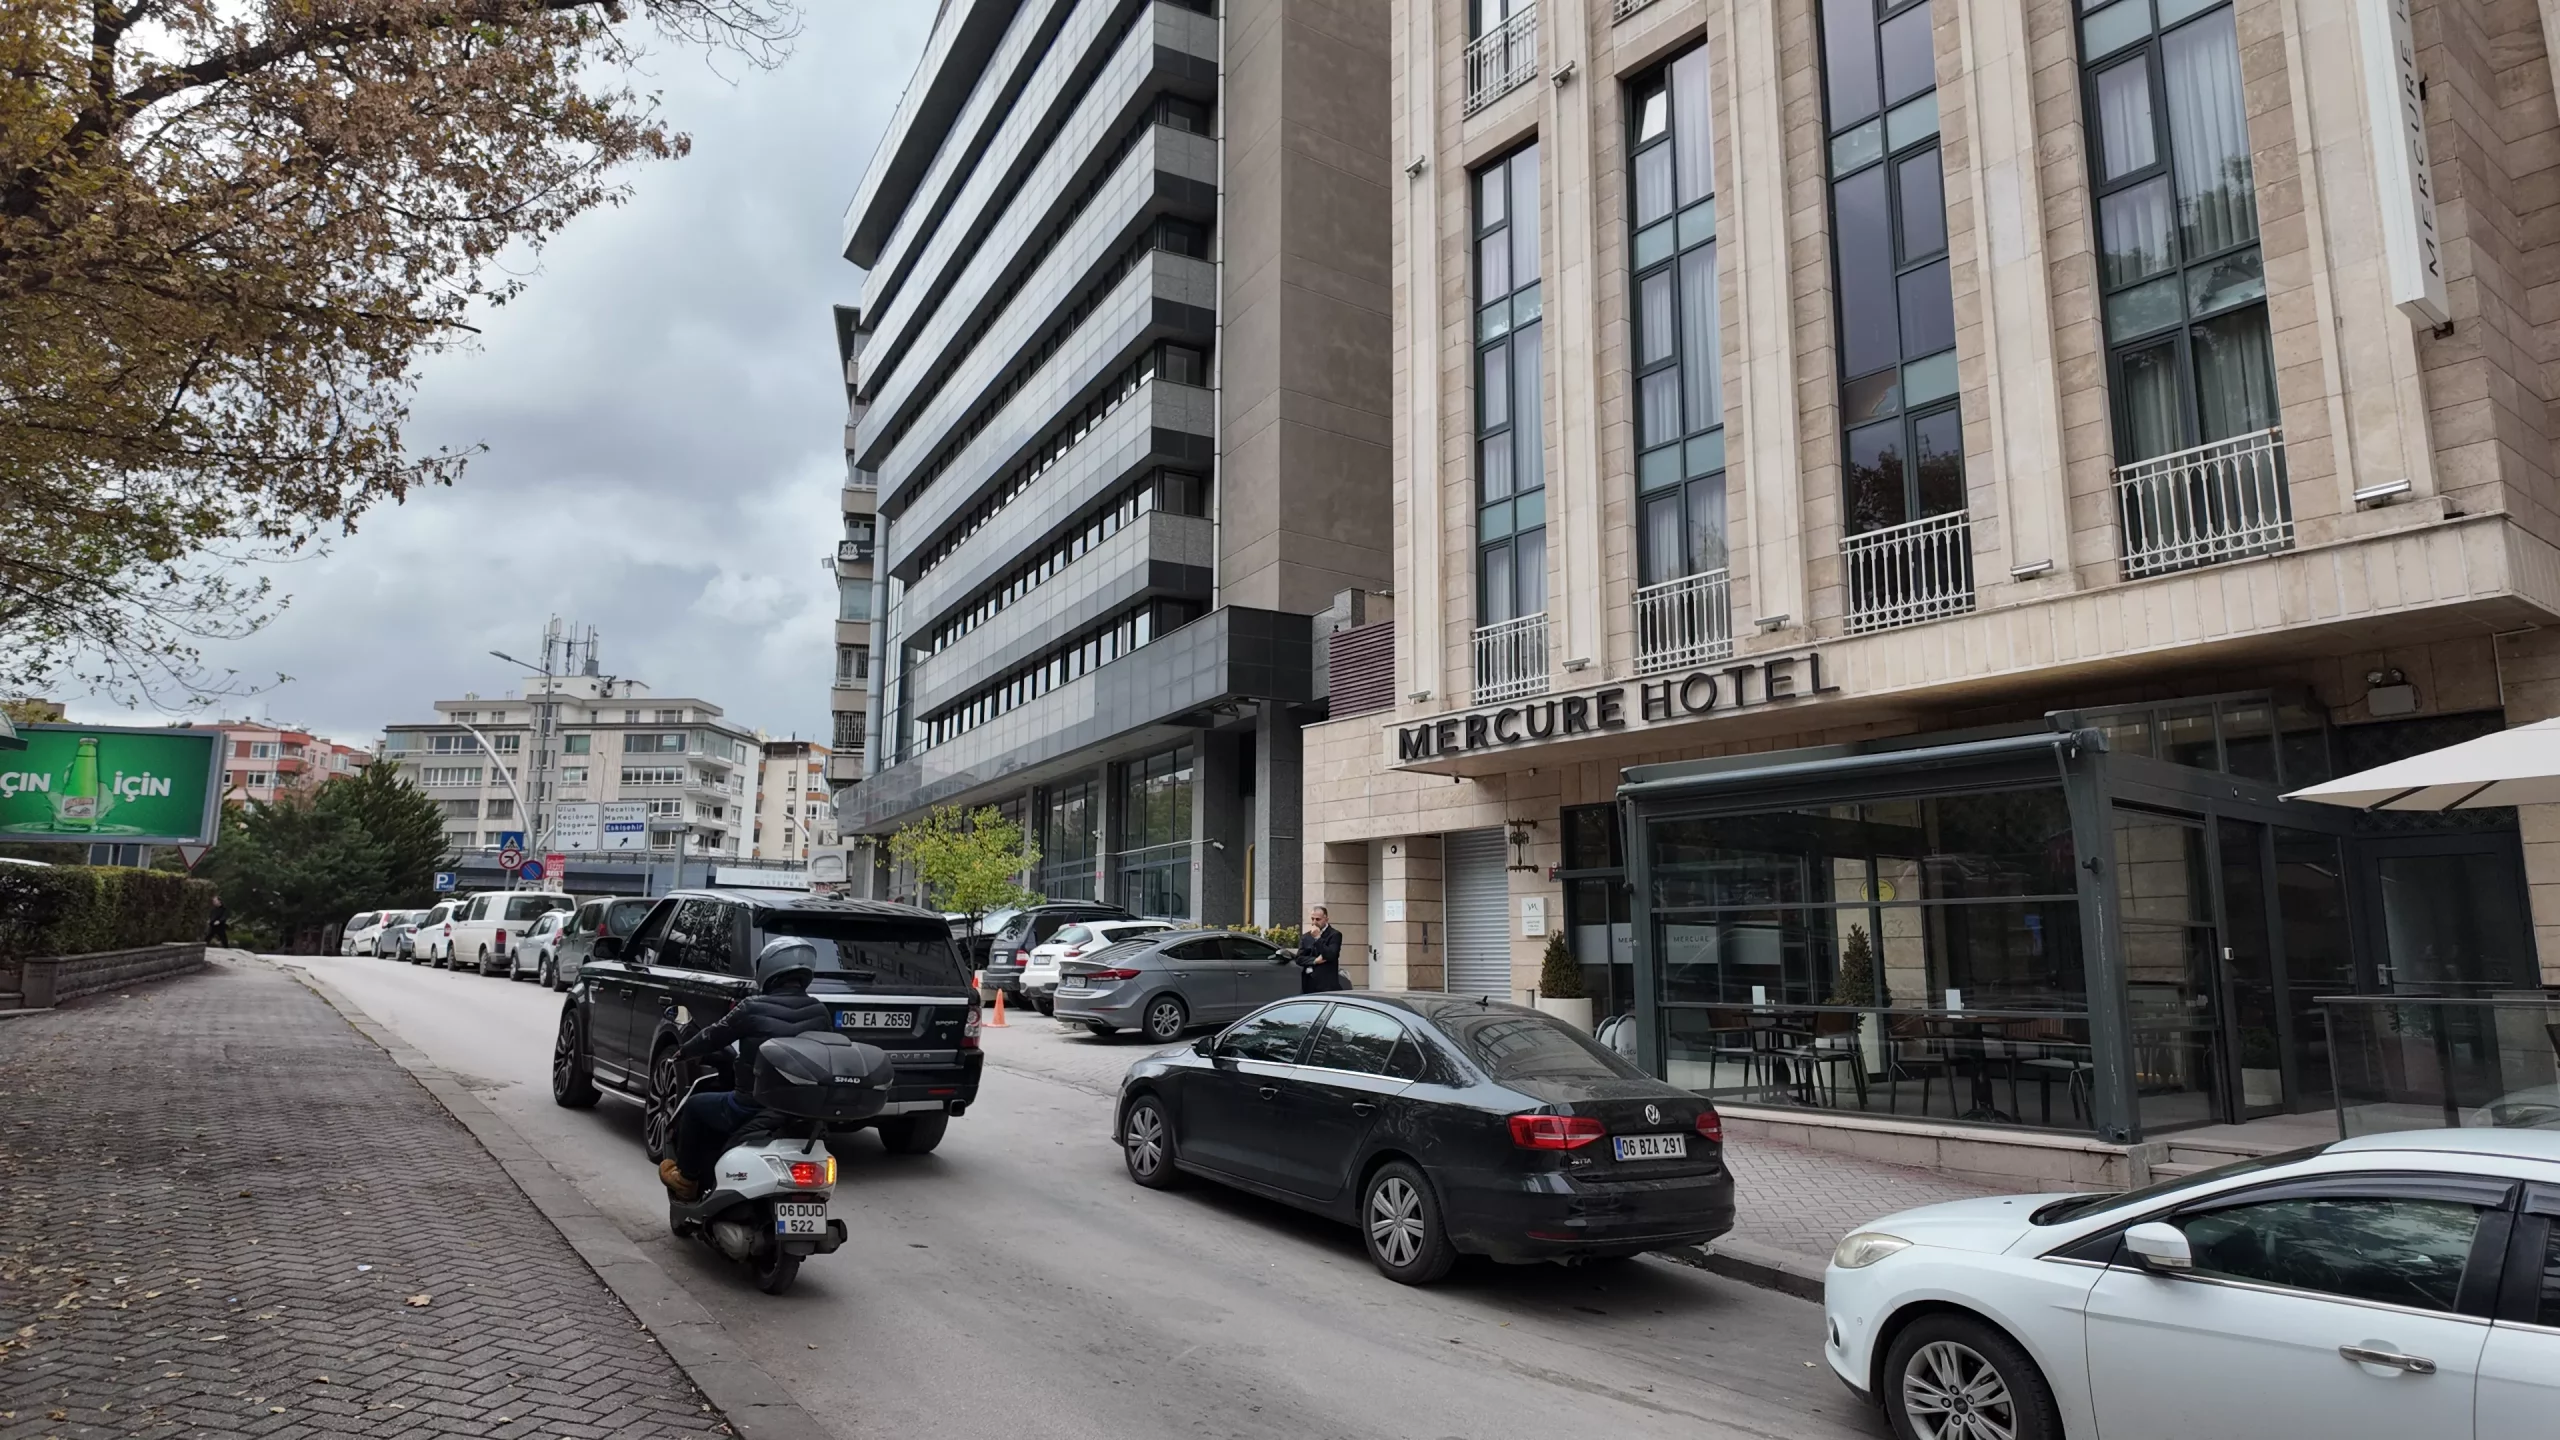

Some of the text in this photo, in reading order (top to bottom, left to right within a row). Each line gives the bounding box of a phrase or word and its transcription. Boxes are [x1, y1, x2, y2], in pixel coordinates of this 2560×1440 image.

[2400, 39, 2440, 278] MERCURE
[1398, 652, 1840, 760] MERCURE HOTEL
[113, 771, 171, 802] İÇİN
[1673, 935, 1710, 943] MERCURE
[842, 1012, 911, 1027] 06 EA 2659
[1622, 1137, 1682, 1156] 06 BZA 291
[779, 1204, 824, 1217] 06 DUD
[790, 1220, 814, 1232] 522
